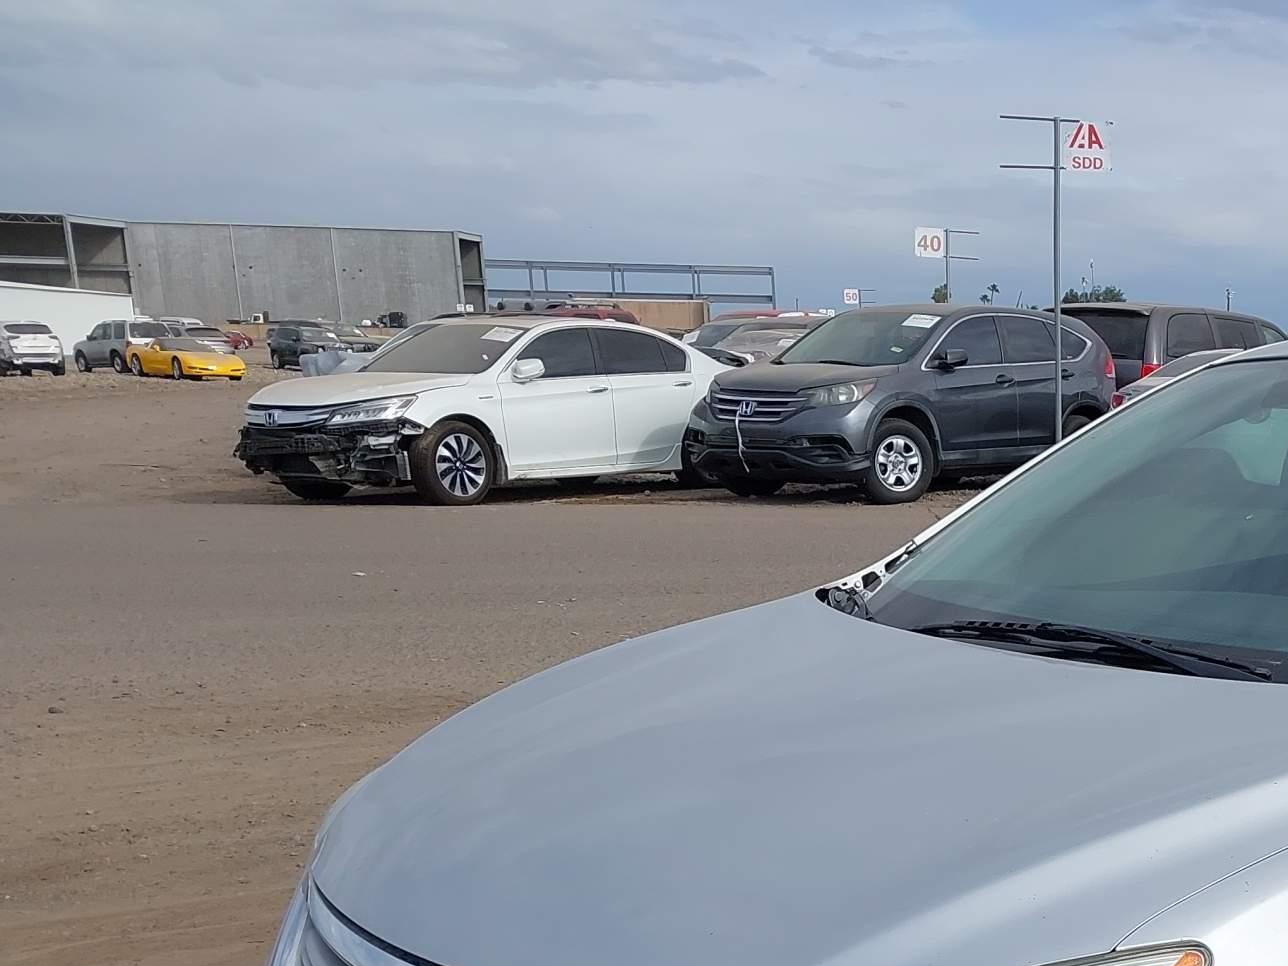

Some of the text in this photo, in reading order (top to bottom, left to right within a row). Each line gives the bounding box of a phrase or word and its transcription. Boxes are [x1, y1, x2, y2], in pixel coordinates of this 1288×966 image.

[1072, 156, 1103, 169] SDD
[917, 234, 941, 252] 40
[845, 292, 857, 301] 50
